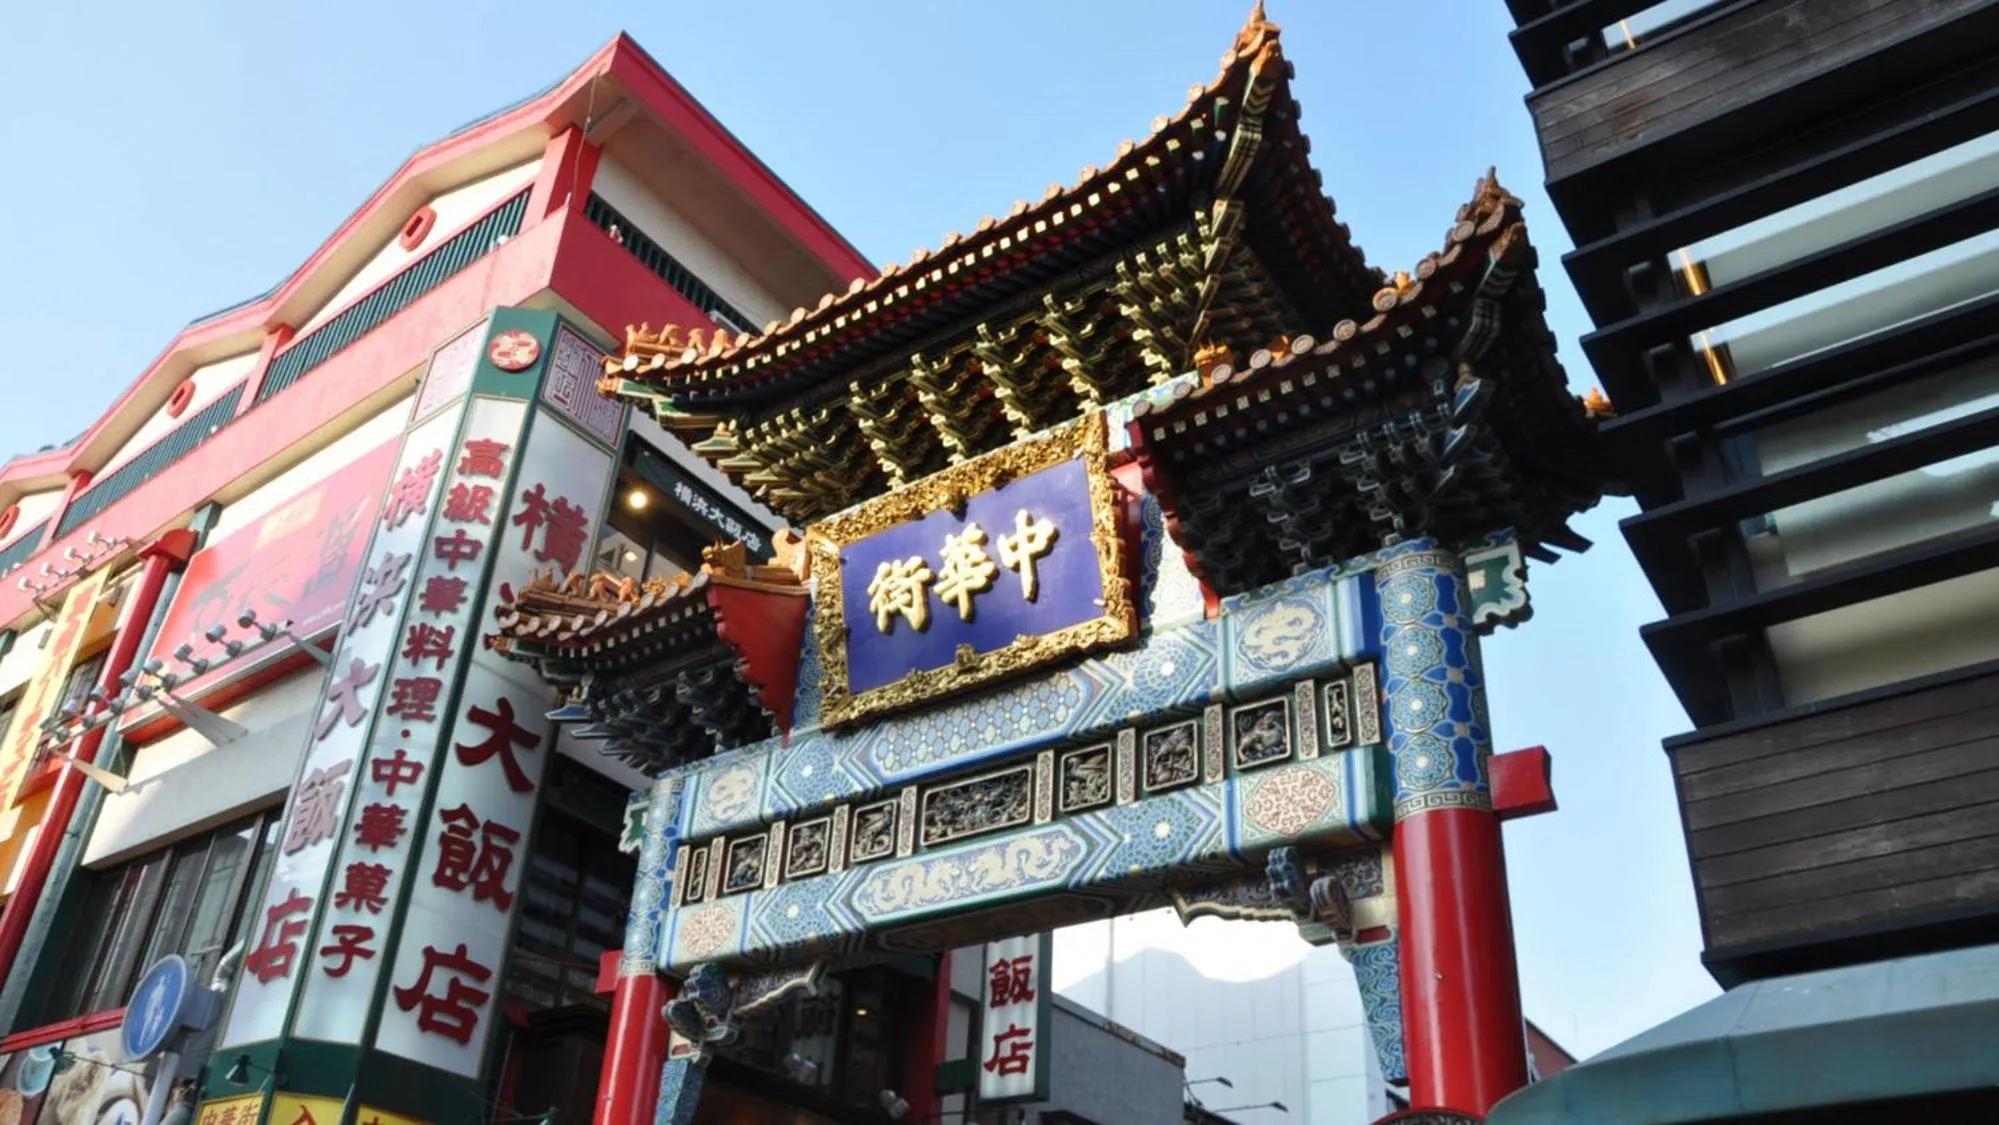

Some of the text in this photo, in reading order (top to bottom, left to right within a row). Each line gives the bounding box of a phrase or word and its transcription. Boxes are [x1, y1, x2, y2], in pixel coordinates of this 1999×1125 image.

[246, 447, 442, 986] 横浜大飯店
[867, 508, 1060, 634] 中華街
[394, 483, 589, 1046] 横大飯店
[983, 955, 1035, 1077] 飯店
